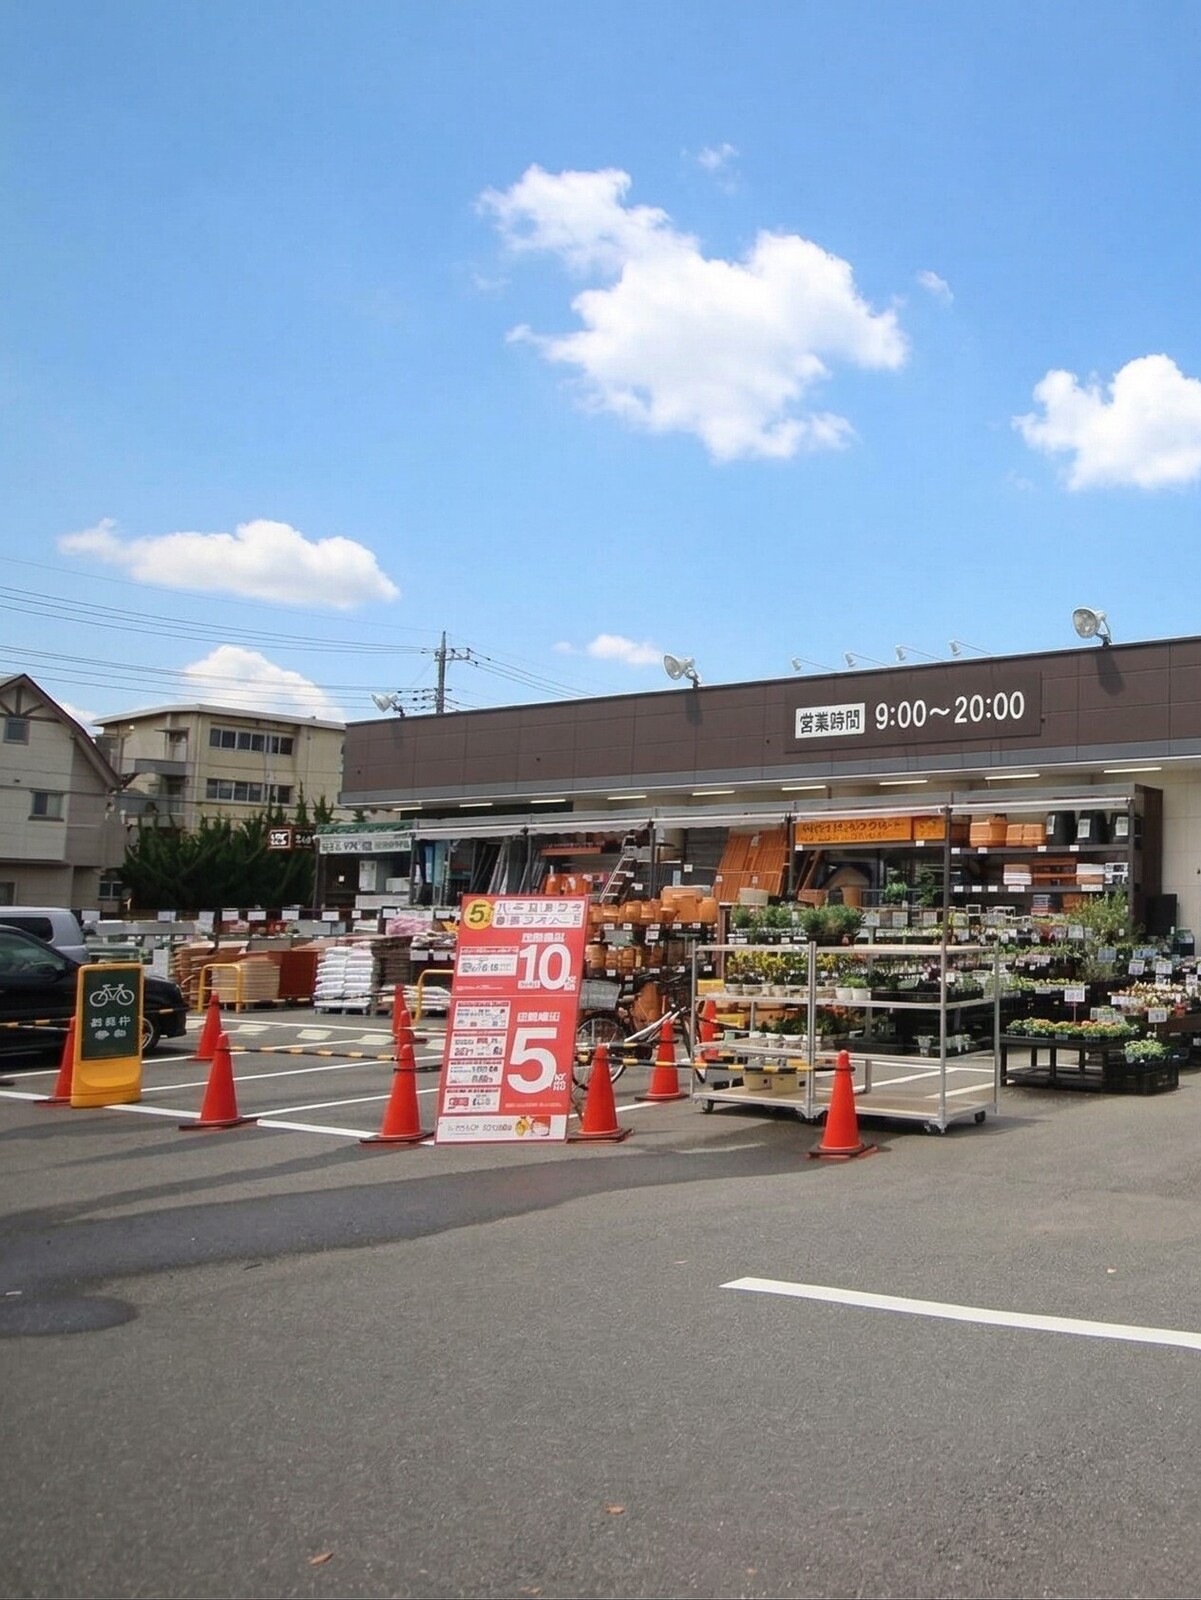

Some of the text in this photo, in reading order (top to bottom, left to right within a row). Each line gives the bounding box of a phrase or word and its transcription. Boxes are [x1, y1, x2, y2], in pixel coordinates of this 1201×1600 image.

[799, 709, 861, 735] 営業時間
[519, 943, 572, 990] 10
[507, 1027, 557, 1094] 5
